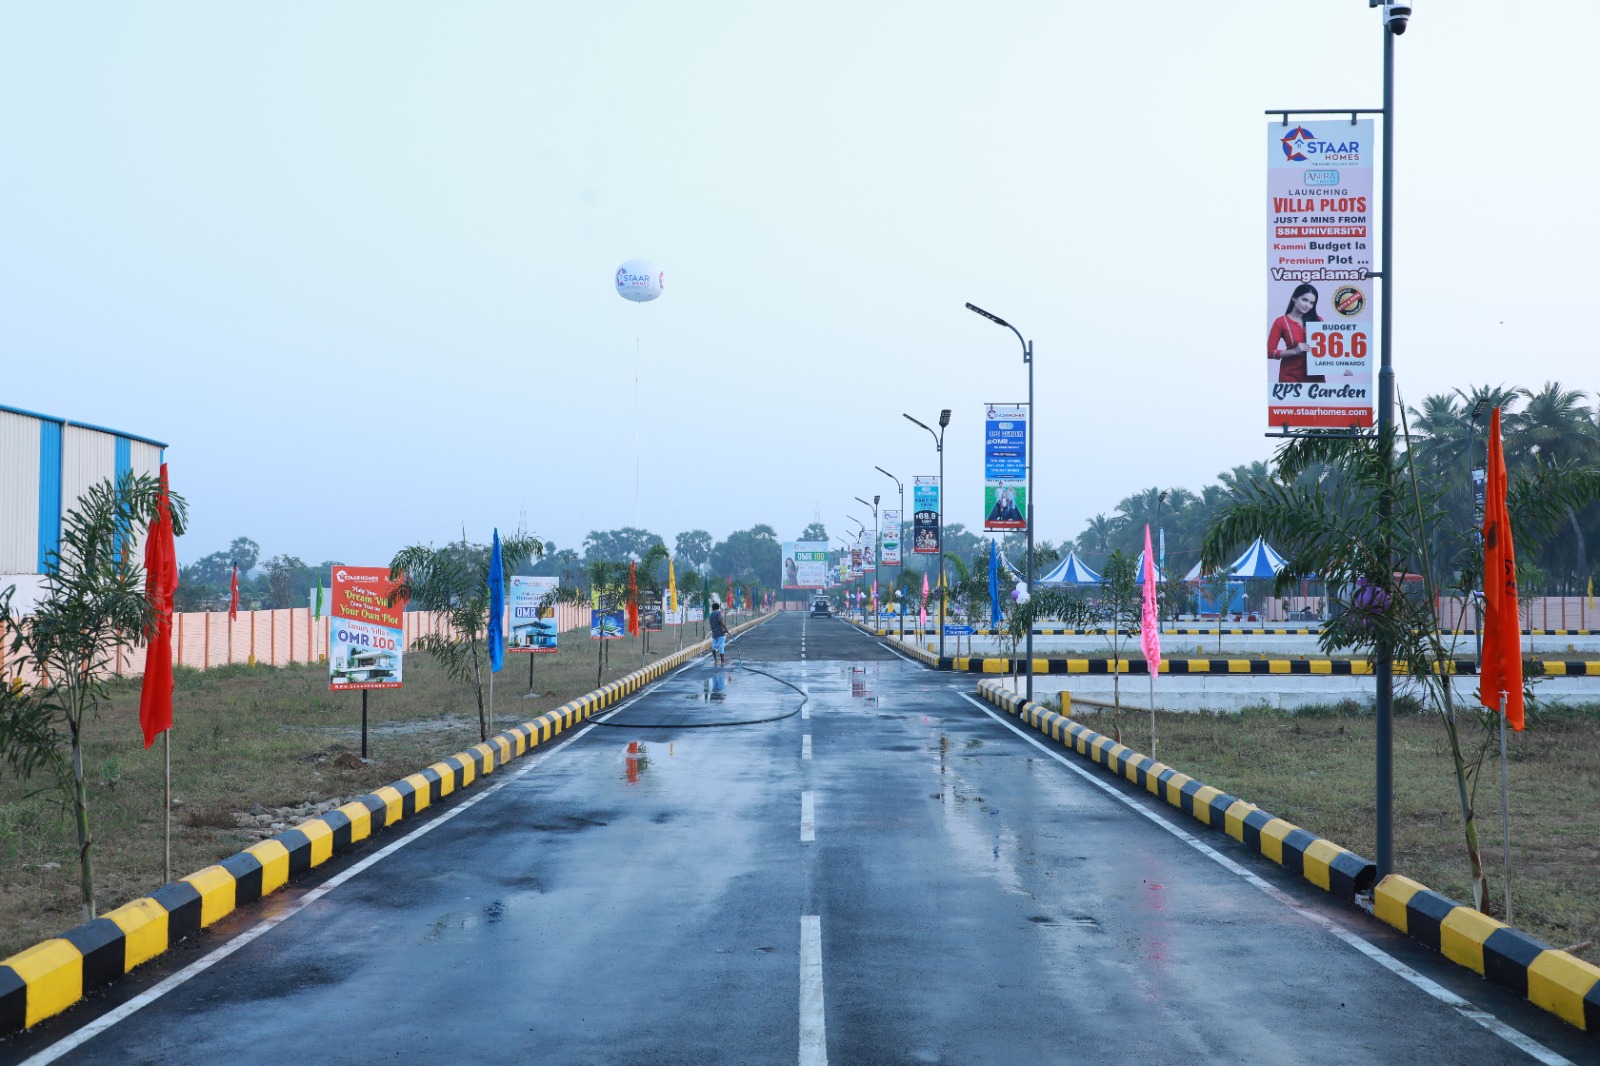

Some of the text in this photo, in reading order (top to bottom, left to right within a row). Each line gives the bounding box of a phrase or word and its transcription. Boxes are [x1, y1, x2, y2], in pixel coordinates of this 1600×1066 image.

[1307, 141, 1360, 154] STAAR
[1273, 196, 1367, 214] VILLA PLOTS
[1309, 242, 1352, 252] Budget
[1327, 255, 1353, 264] Plot
[1272, 268, 1369, 283] Vangalama?
[1311, 332, 1367, 358] 36.6
[1272, 384, 1366, 400] RPS Garden
[345, 590, 390, 607] Dream Vill
[339, 604, 399, 624] Your Own Plot
[517, 607, 536, 617] OMR
[347, 622, 368, 633] Luxury
[338, 630, 394, 650] OMR 100
